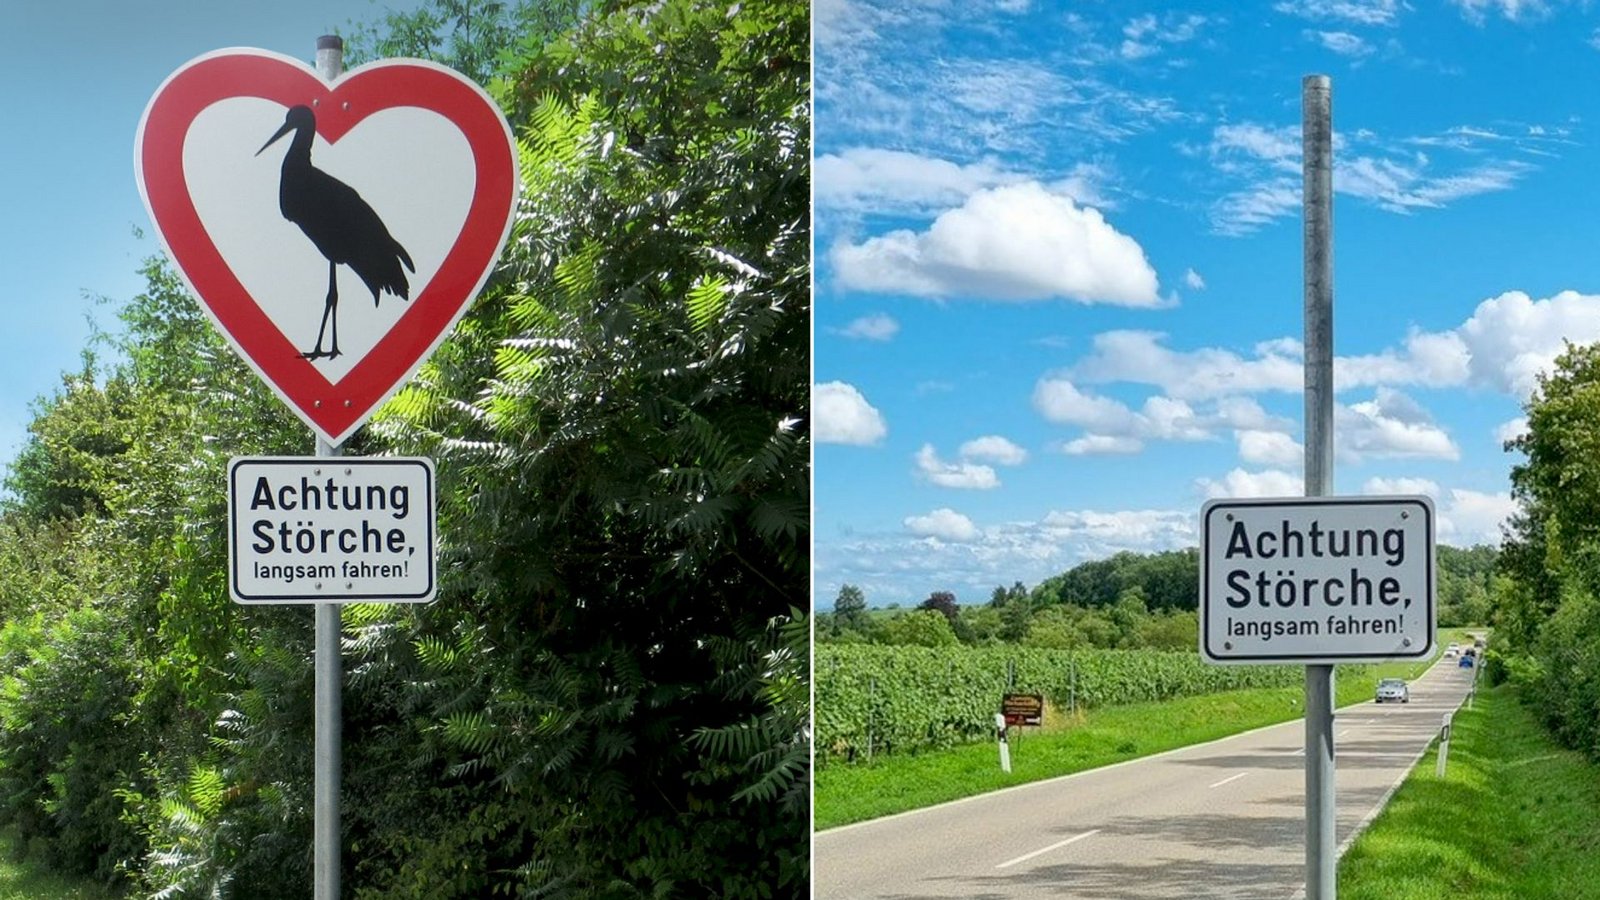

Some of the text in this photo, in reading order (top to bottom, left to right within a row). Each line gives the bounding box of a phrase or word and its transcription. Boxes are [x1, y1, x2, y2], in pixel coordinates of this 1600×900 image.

[250, 476, 409, 519] Achtung
[252, 519, 415, 557] Störche,
[1225, 520, 1405, 566] Achtung
[254, 560, 409, 583] langsam fahren!
[1226, 568, 1411, 609] Störche,
[1228, 614, 1403, 641] langsam fahren!
